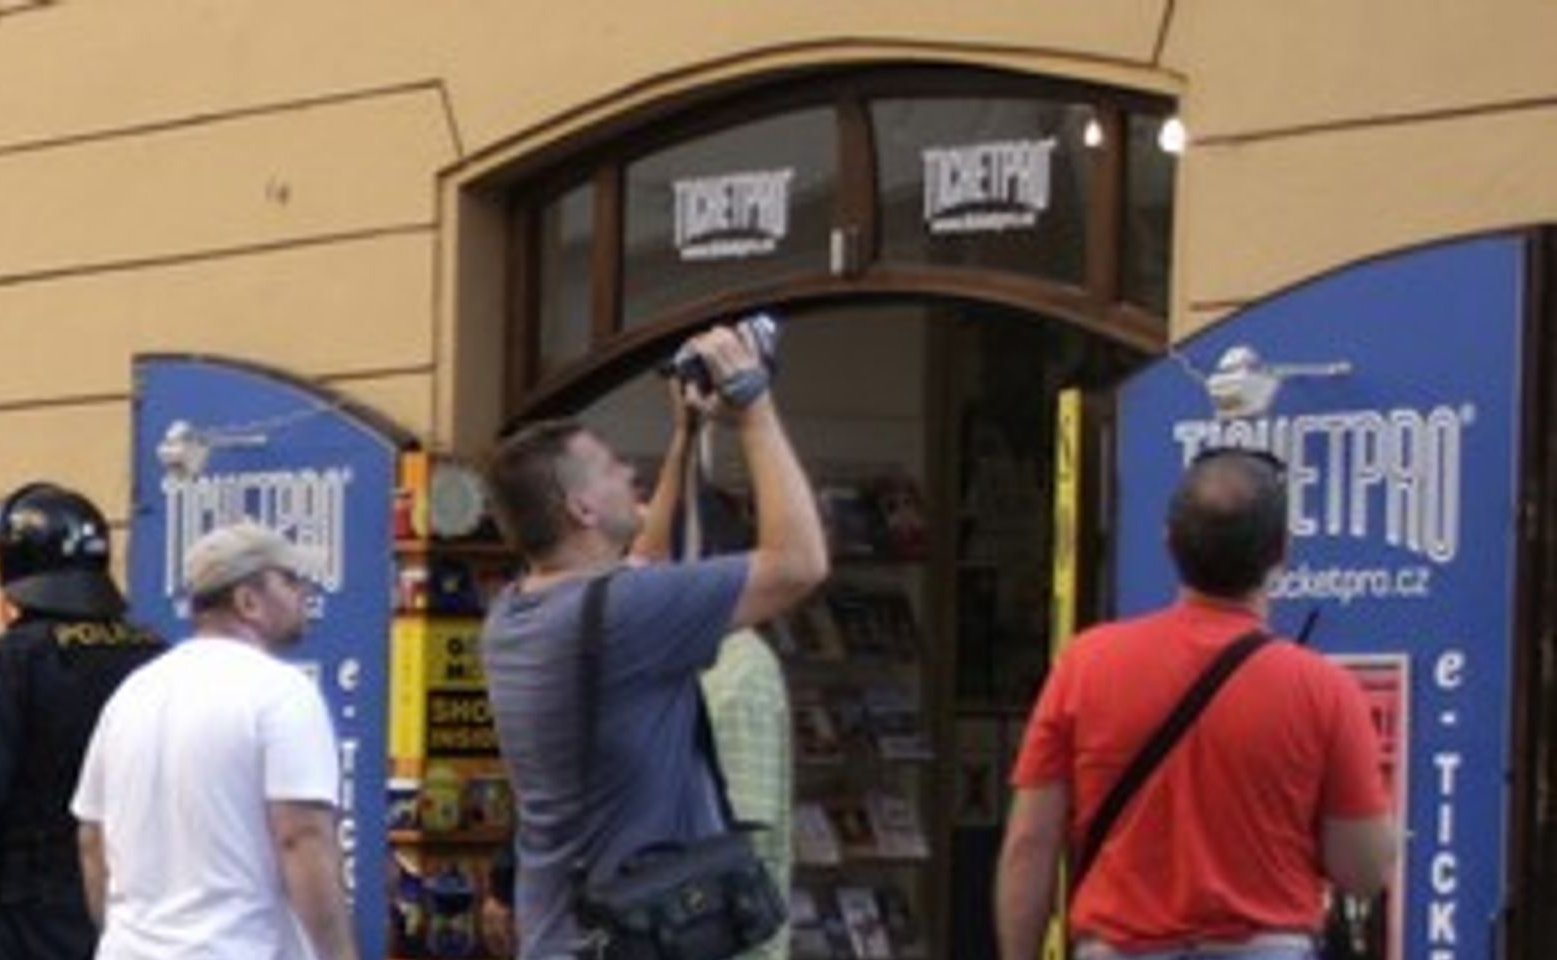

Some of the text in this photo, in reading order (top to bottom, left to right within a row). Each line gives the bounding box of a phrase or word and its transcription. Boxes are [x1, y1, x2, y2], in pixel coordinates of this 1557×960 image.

[673, 167, 793, 246] TICKETPRO
[923, 136, 1056, 219] TICKETPRO
[1174, 405, 1460, 562] ETPRO
[431, 699, 493, 724] SHO
